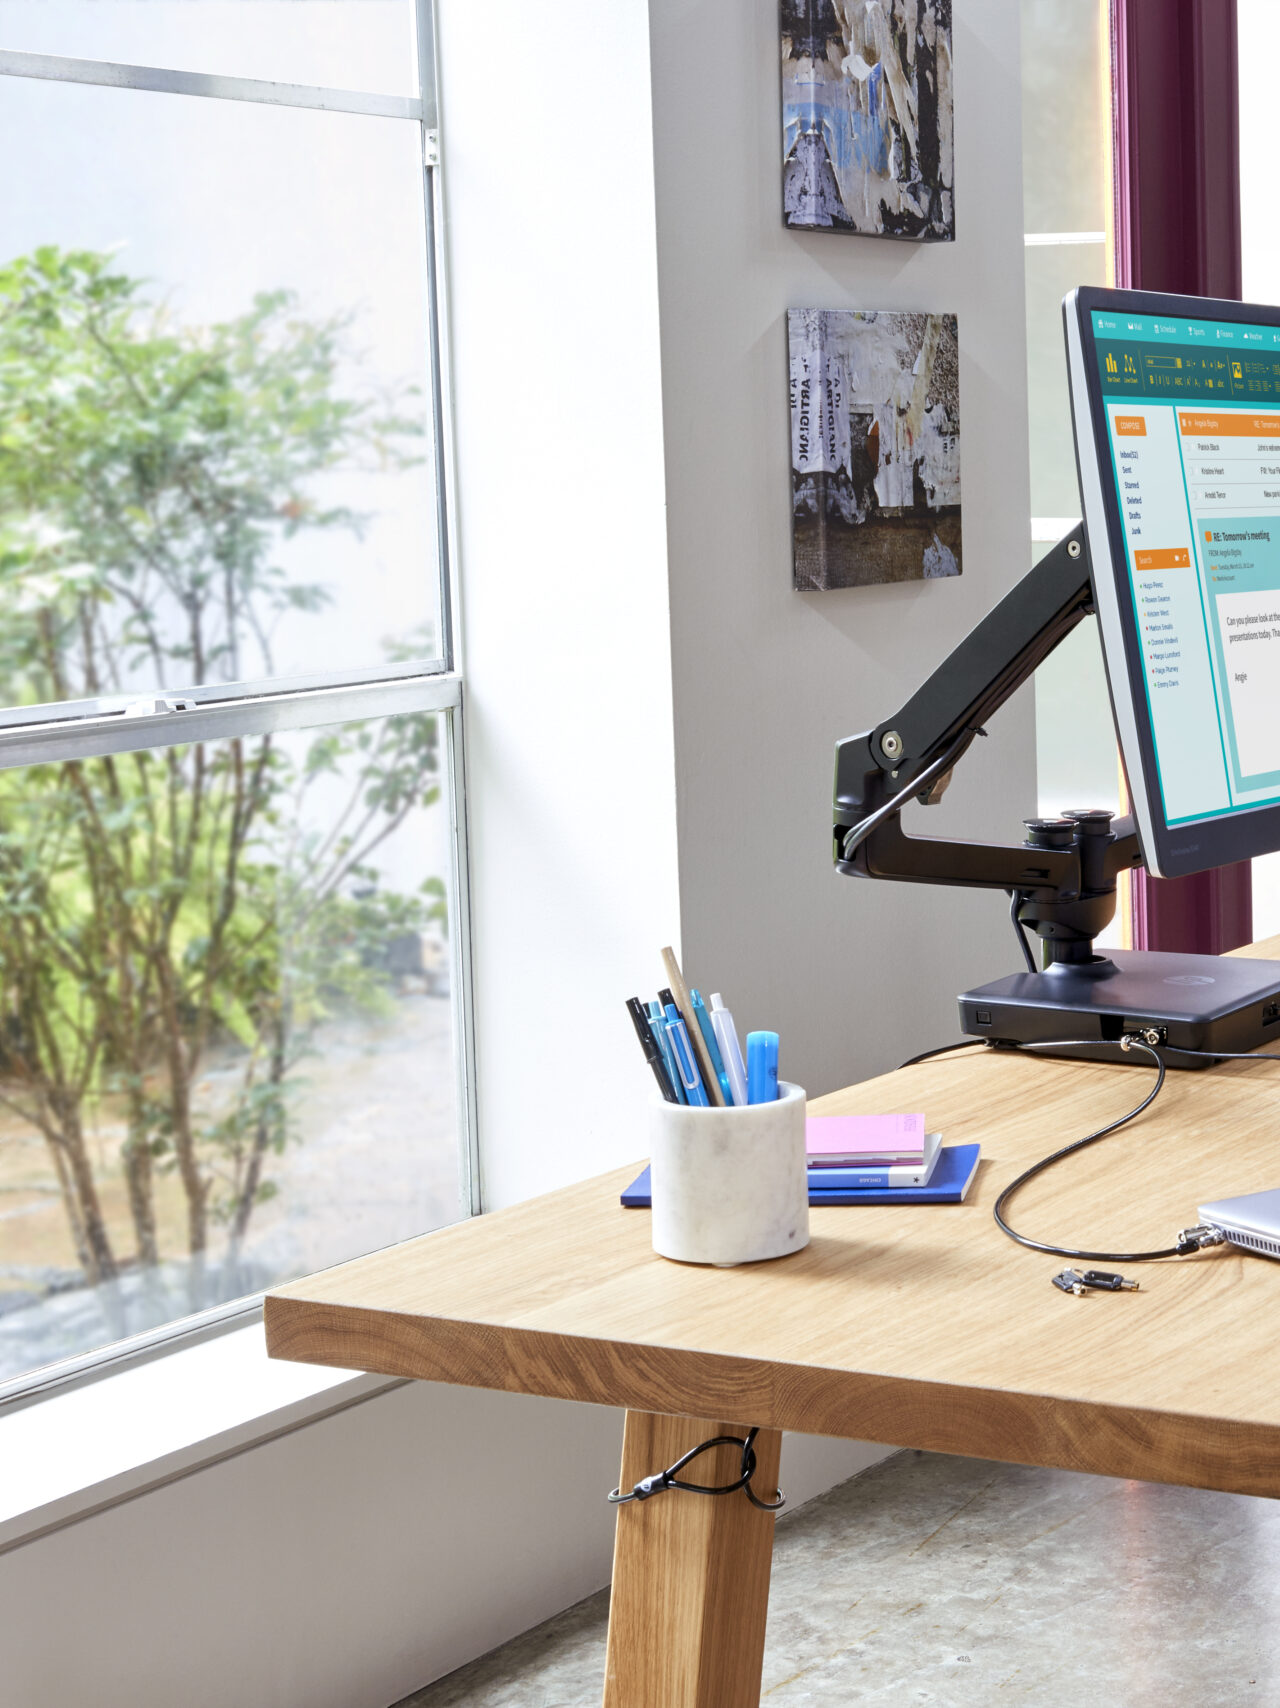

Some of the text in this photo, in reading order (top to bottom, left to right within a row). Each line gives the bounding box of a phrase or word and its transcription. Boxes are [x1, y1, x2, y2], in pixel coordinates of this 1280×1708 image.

[1126, 496, 1142, 505] Deleted
[1213, 530, 1271, 542] RE: Tomorrow's meeting
[1226, 616, 1236, 626] Can
[1236, 617, 1245, 628] you
[1244, 614, 1259, 626] please
[1258, 613, 1268, 623] look
[1273, 612, 1280, 621] the
[1228, 631, 1259, 645] presentations
[1234, 672, 1248, 684] Angie
